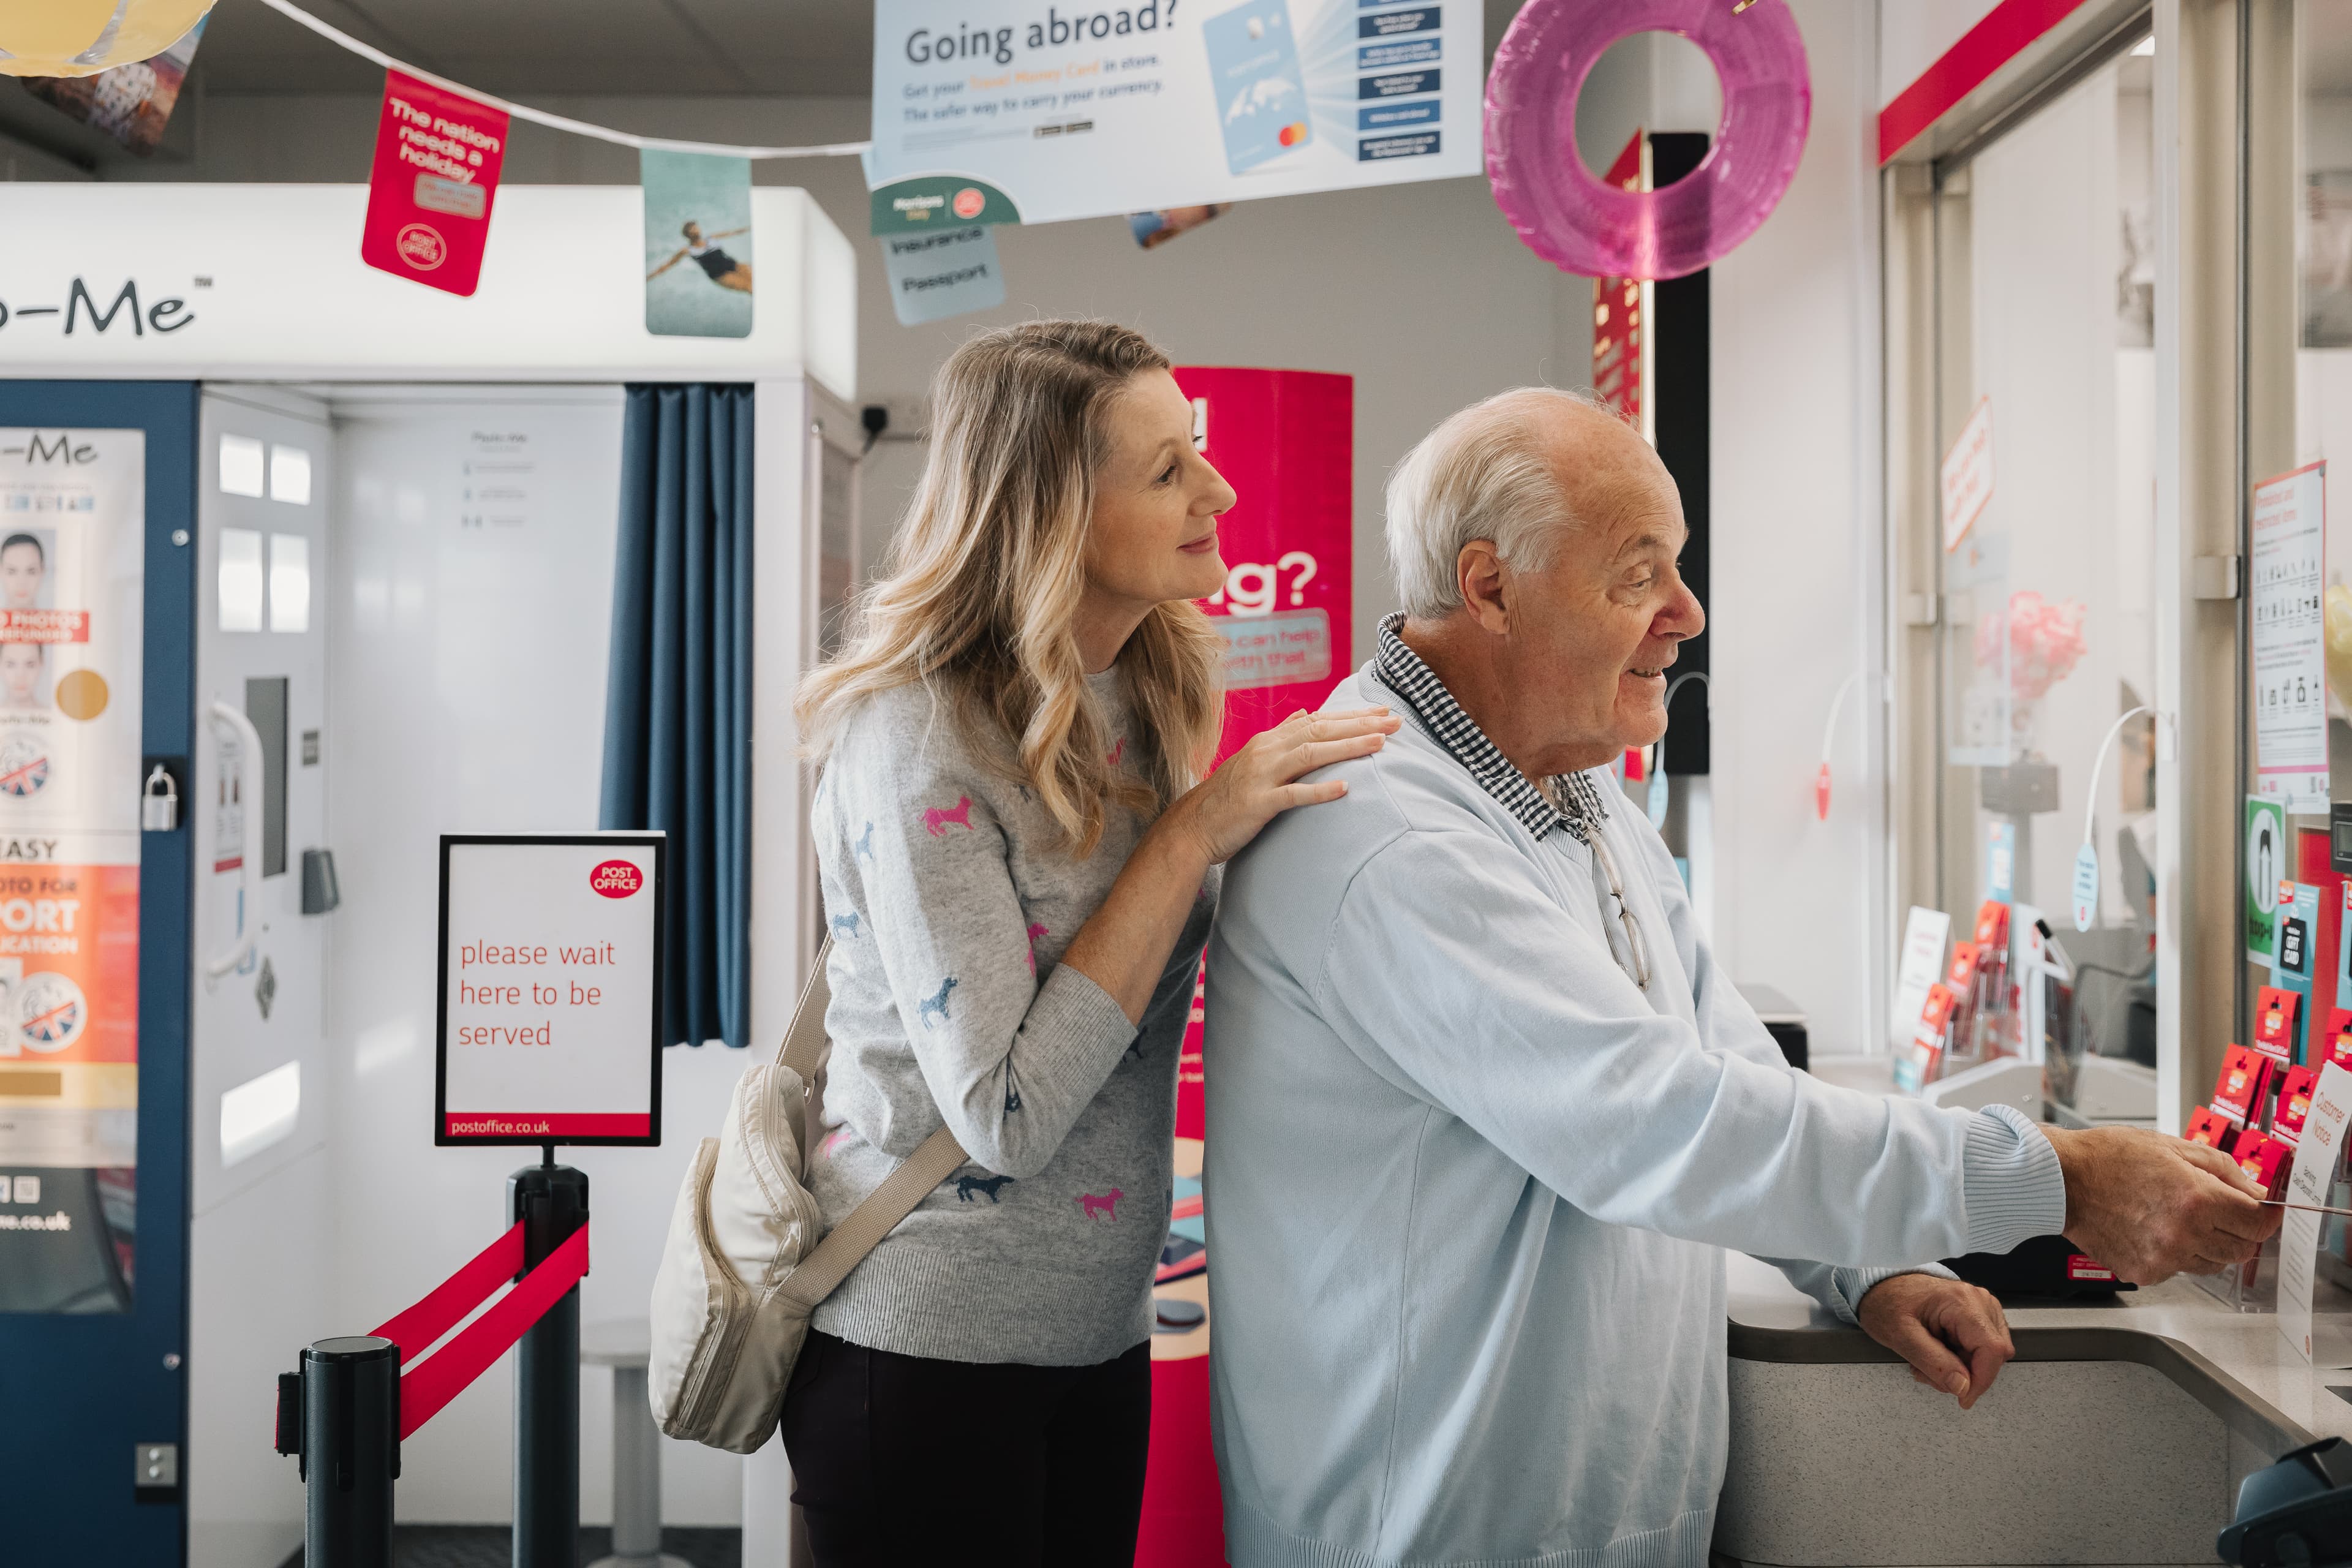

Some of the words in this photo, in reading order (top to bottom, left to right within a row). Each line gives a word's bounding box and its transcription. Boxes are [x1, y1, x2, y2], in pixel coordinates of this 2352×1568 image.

[907, 21, 1014, 65] Going
[1027, 0, 1178, 50] abroad?
[903, 81, 929, 100] Get
[933, 80, 965, 102] your
[970, 72, 1010, 91] Travel
[1014, 67, 1062, 89] Money
[1065, 58, 1101, 80] Card
[1104, 56, 1118, 72] in
[903, 105, 929, 123] The
[932, 102, 969, 121] safer
[971, 100, 999, 118] way
[1003, 96, 1018, 112] to
[1022, 92, 1058, 111] carry
[1062, 88, 1095, 107] your
[389, 97, 432, 129] The
[433, 118, 500, 153] nation
[399, 124, 467, 162] needs
[467, 149, 483, 168] a
[399, 143, 477, 186] holiday
[1237, 633, 1278, 648] can
[1280, 627, 1321, 649] help
[1267, 648, 1306, 668] that
[594, 878, 638, 890] OFFICE
[600, 866, 634, 879] POST
[0, 899, 80, 933] ORT
[461, 939, 548, 970] please
[559, 941, 616, 966] wait
[459, 980, 521, 1006] here
[532, 982, 558, 1006] to
[570, 981, 602, 1006] be
[459, 1021, 551, 1046] served
[2316, 1090, 2345, 1126] Customer
[451, 1119, 550, 1136] postoffice.co.uk
[2312, 1118, 2332, 1147] Notice
